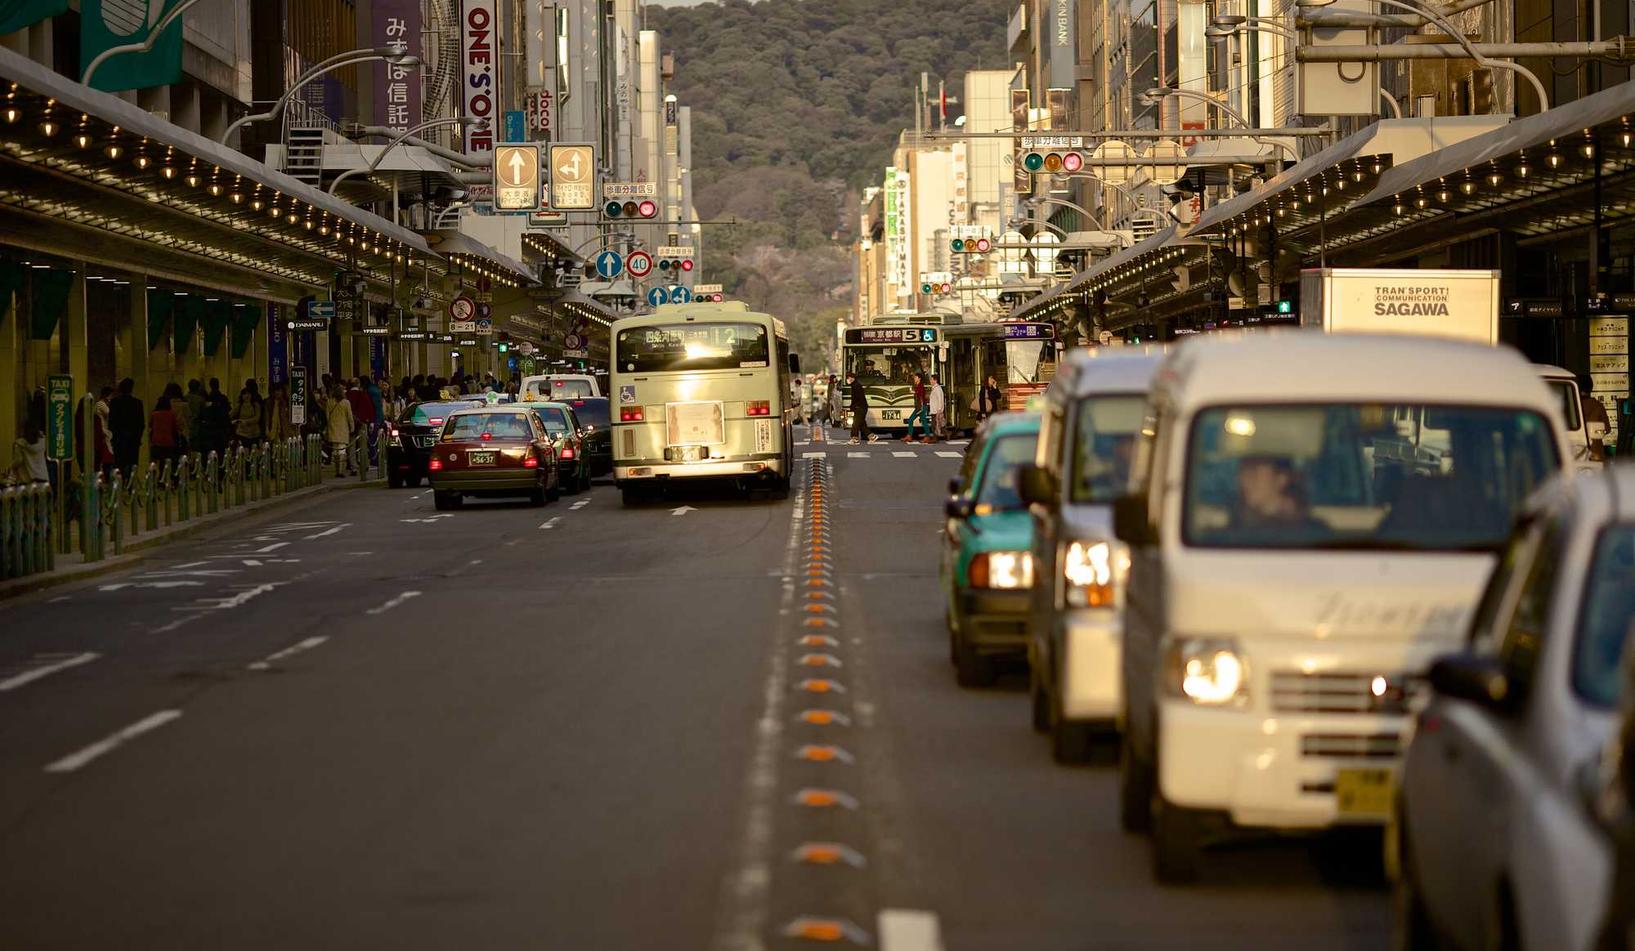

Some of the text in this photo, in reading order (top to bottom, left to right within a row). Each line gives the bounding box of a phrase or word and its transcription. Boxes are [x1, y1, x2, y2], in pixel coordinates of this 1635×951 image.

[540, 90, 552, 131] doco
[898, 191, 906, 288] TAKASHIMAYA
[632, 258, 647, 270] 40
[1374, 302, 1449, 316] SAGAWA
[905, 330, 917, 340] 5
[292, 370, 304, 378] TAXI
[51, 380, 70, 388] TAXI
